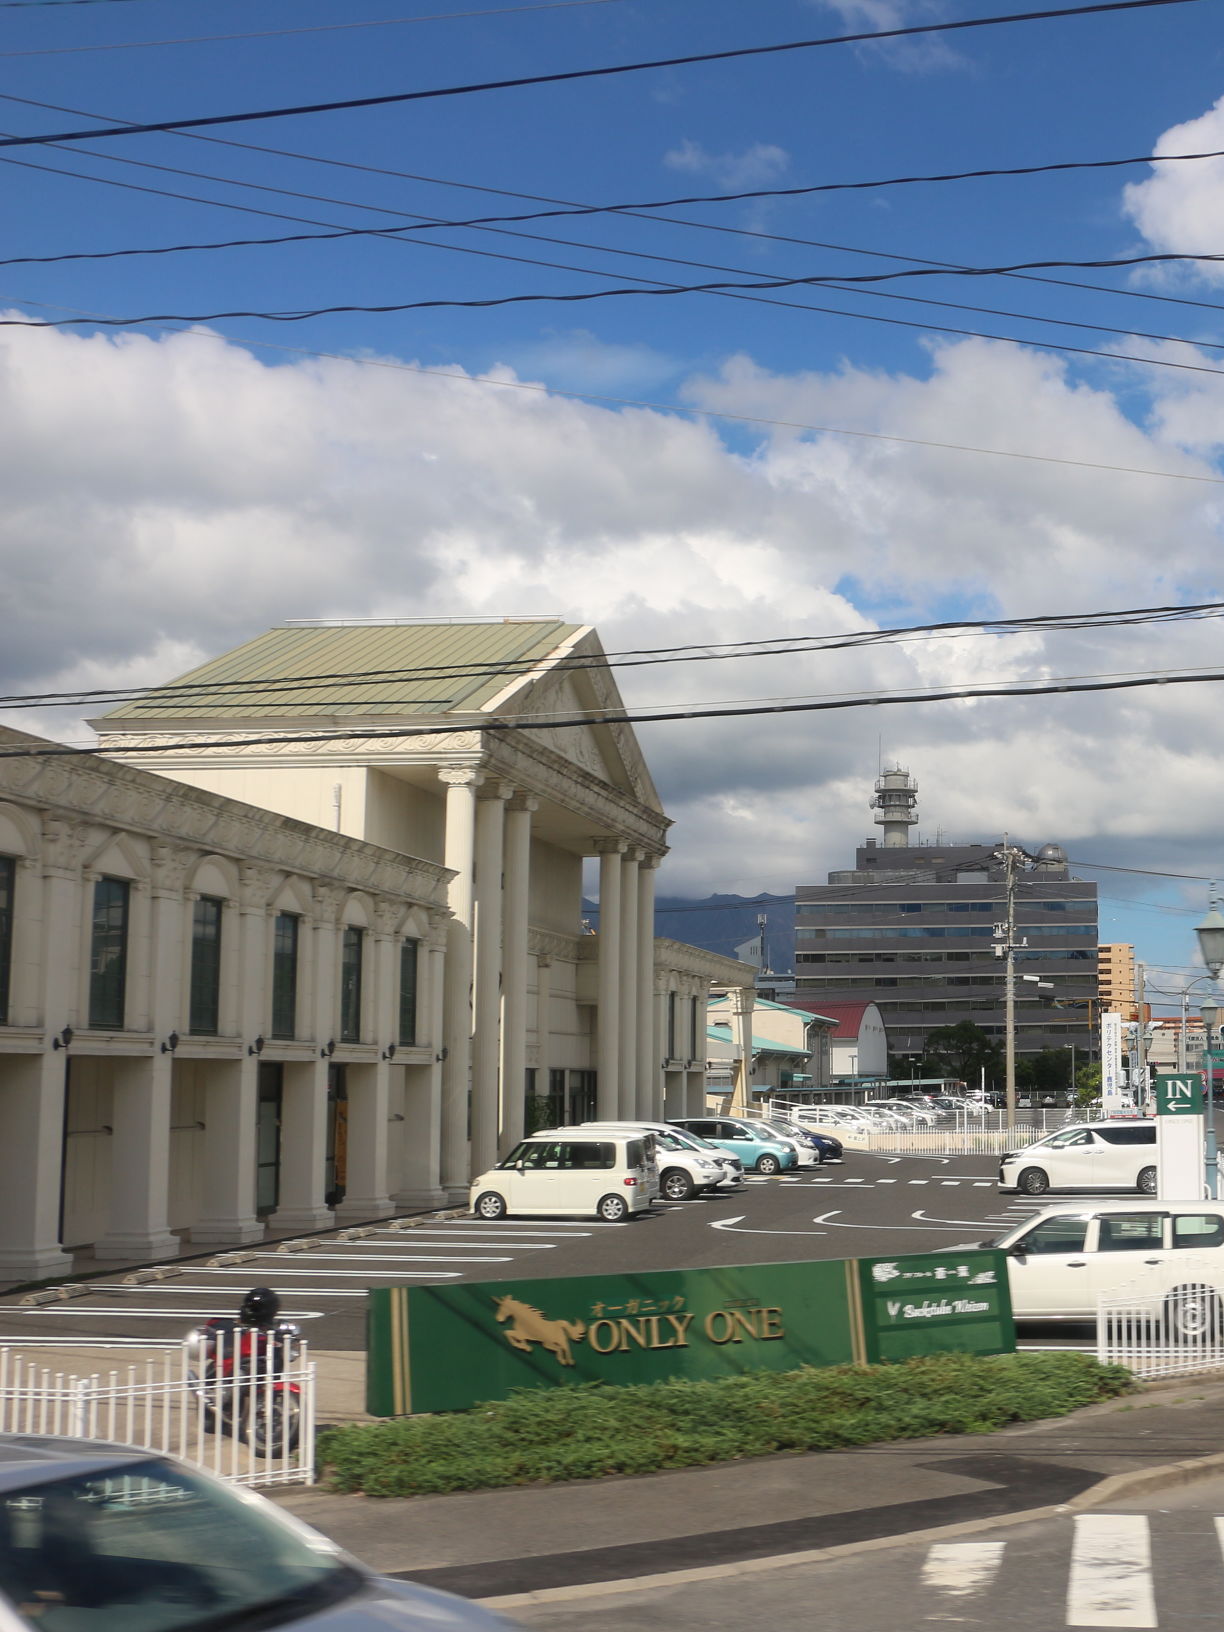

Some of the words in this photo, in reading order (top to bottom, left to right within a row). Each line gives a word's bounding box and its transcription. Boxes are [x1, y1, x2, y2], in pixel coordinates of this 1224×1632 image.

[1165, 1080, 1194, 1099] IN
[588, 1313, 695, 1353] ONLY
[704, 1307, 785, 1343] ONE
